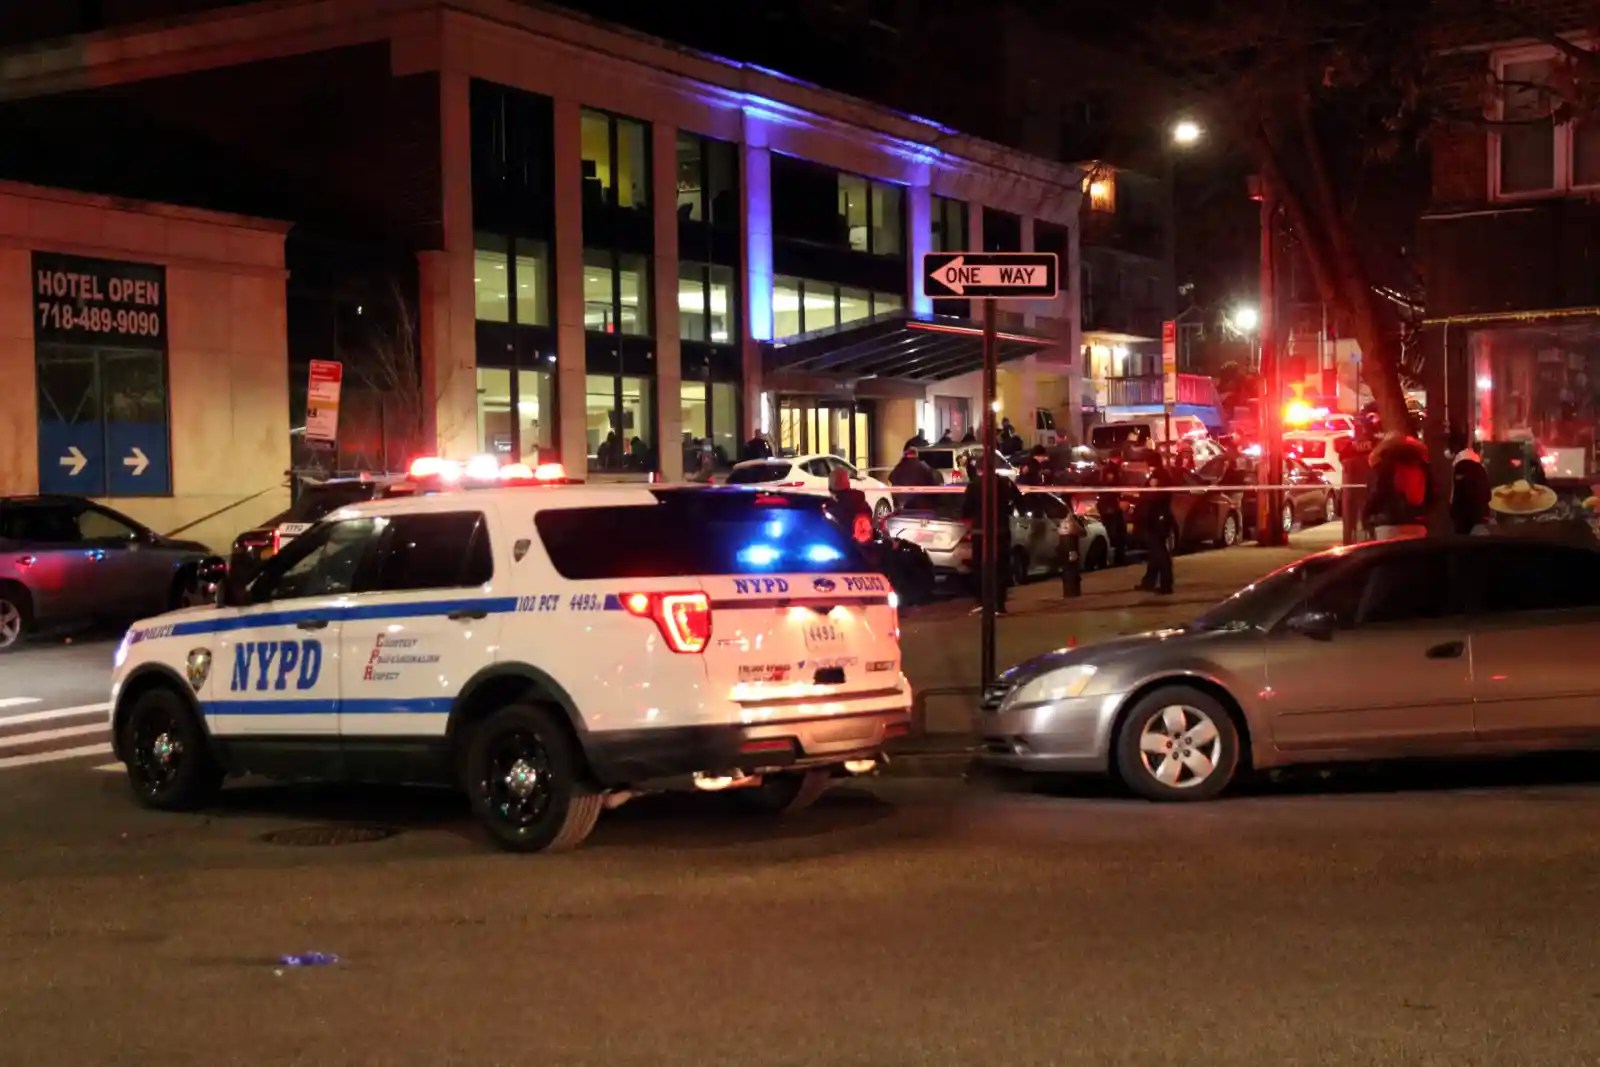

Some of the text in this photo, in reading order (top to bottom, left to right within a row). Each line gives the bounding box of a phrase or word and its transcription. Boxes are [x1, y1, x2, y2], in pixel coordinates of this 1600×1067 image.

[38, 270, 160, 306] HOTEL OPEN
[946, 267, 1036, 284] ONE WAY
[39, 302, 160, 337] 718-489-9090
[733, 577, 789, 594] NYPD
[519, 595, 536, 611] 102
[539, 594, 560, 611] PCT
[230, 639, 322, 692] NYPD
